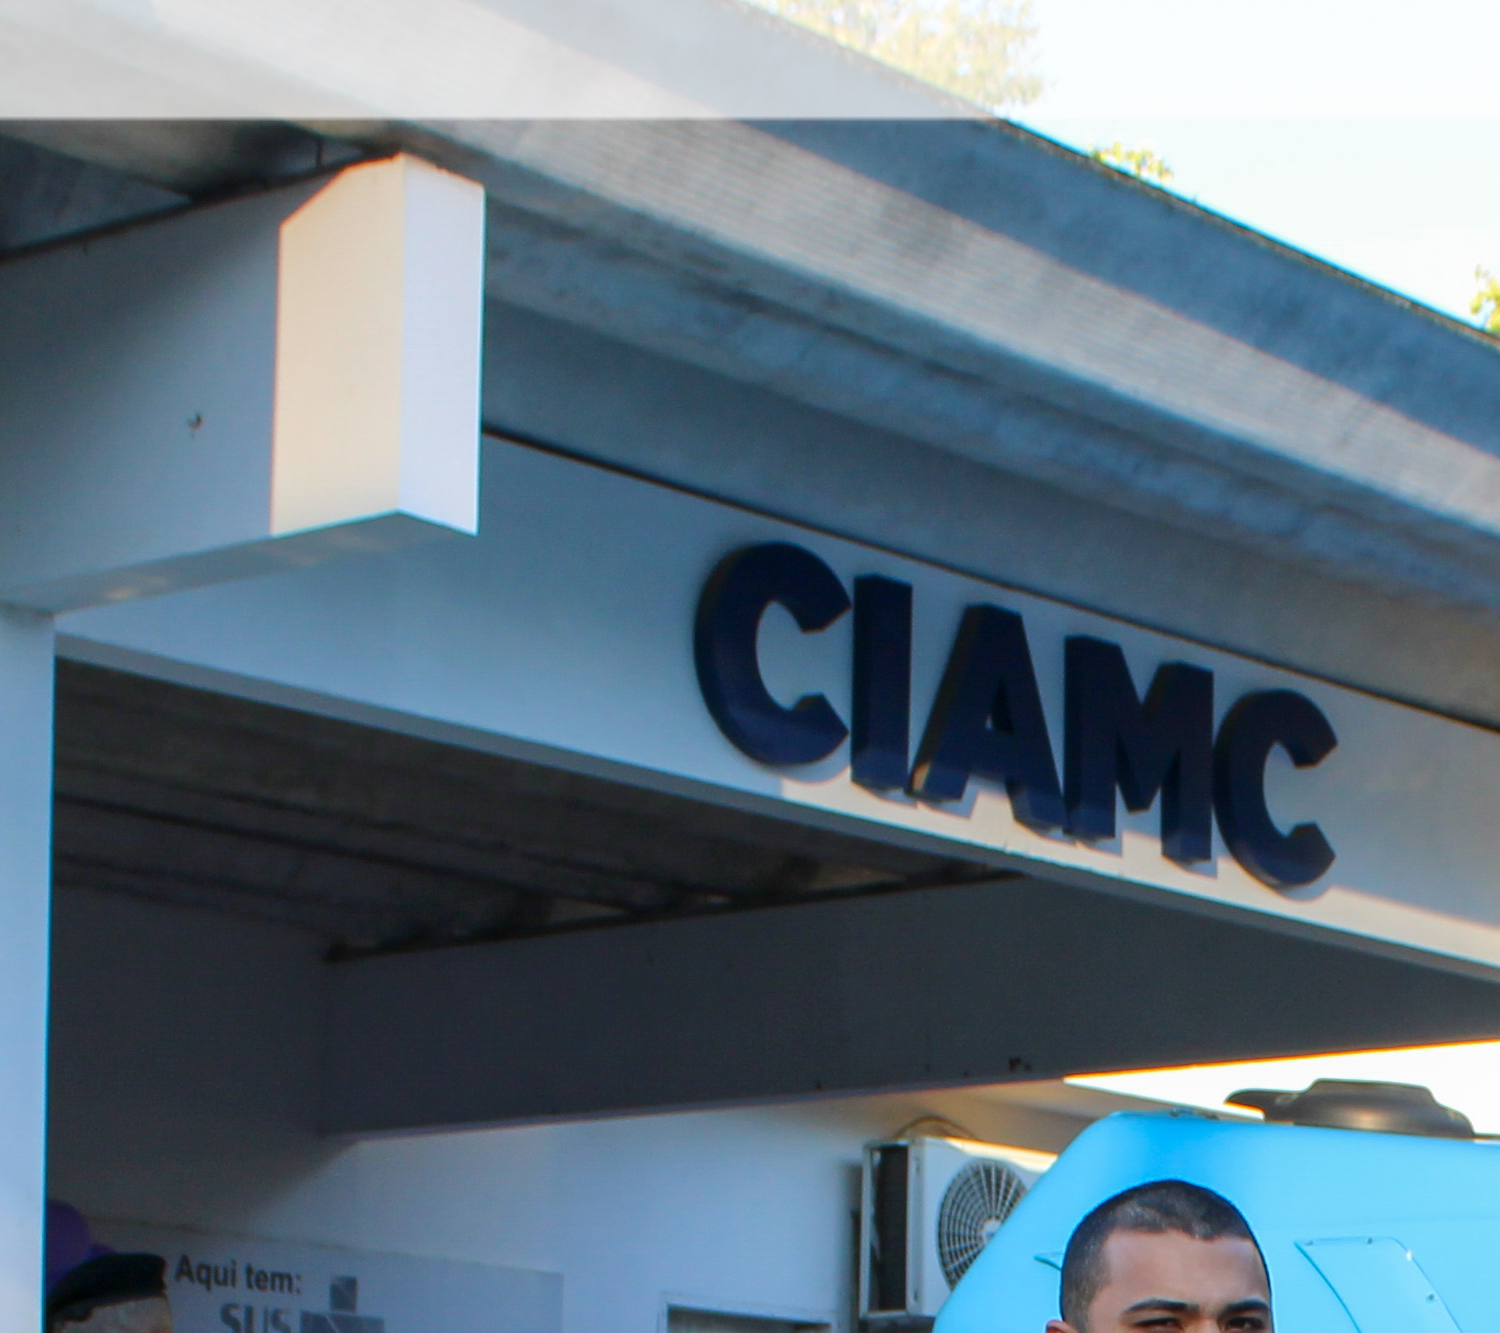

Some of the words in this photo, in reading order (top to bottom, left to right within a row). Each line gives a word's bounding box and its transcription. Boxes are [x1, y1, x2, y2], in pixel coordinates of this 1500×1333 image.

[694, 541, 1337, 888] CIAMC
[175, 1254, 238, 1291] Aqui
[246, 1263, 303, 1294] tem:
